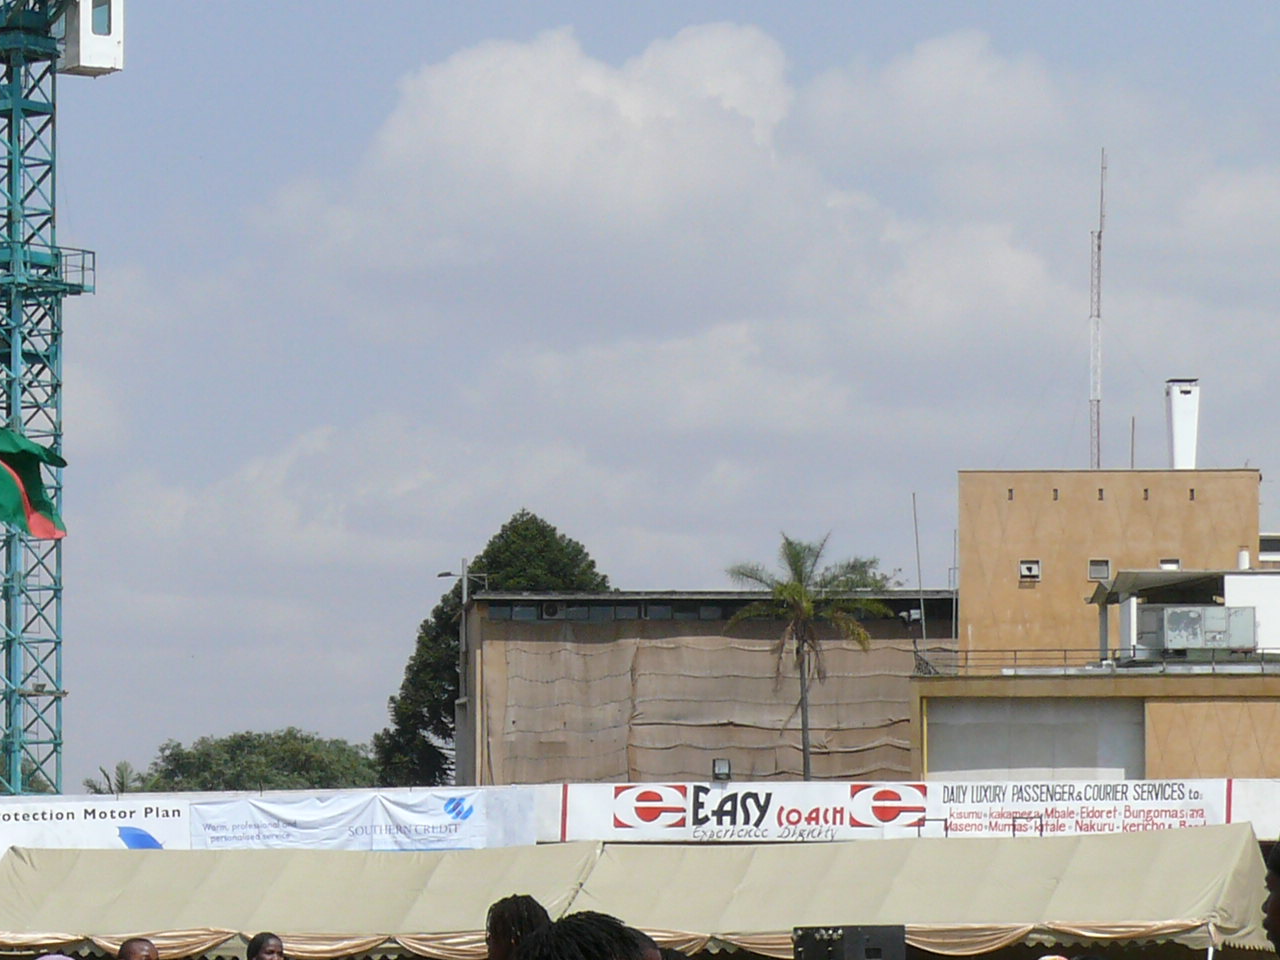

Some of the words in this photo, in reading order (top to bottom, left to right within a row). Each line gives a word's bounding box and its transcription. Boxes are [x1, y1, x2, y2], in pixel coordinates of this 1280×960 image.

[943, 785, 967, 804] DAILY
[971, 784, 1007, 803] LUXURY
[1084, 783, 1128, 801] COURIER
[1133, 783, 1185, 801] SERVICES
[84, 808, 136, 819] Motor
[144, 807, 181, 818] Plan
[692, 785, 772, 828] EASY
[777, 806, 844, 827] COACH
[348, 824, 411, 836] SOUTHERN
[415, 823, 460, 835] CREDIT
[1034, 819, 1066, 832] ktale
[1074, 820, 1114, 832] Nakuru
[692, 826, 768, 841] Experience
